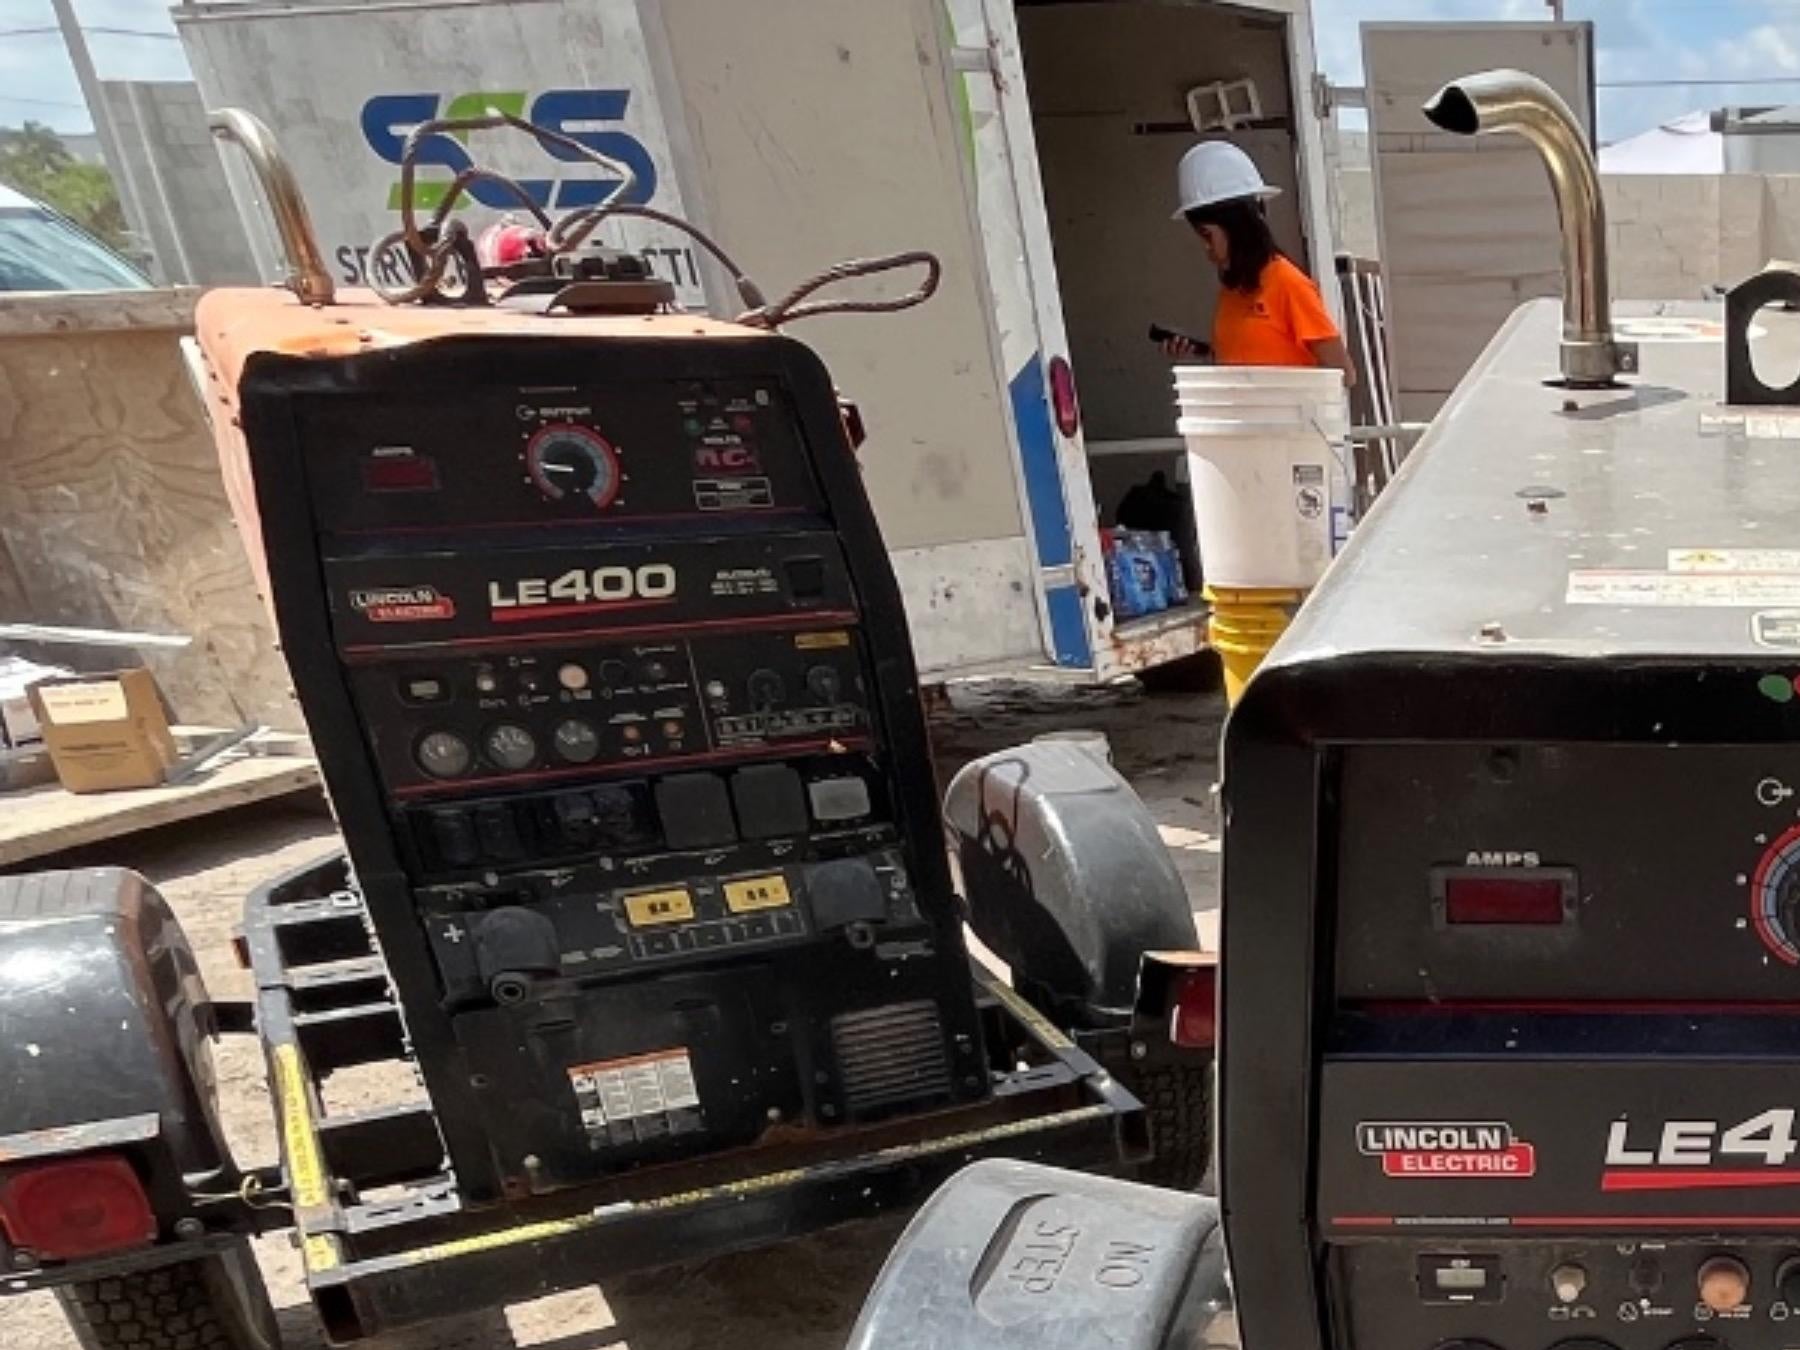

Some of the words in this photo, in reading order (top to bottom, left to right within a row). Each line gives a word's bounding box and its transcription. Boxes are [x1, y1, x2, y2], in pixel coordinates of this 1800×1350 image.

[361, 90, 656, 210] SCS
[488, 563, 676, 607] LE400
[1466, 851, 1540, 867] AMPS
[1367, 1126, 1502, 1151] LINCOLN
[1402, 1154, 1518, 1173] ELECTRIC
[1008, 1220, 1081, 1293] STEP
